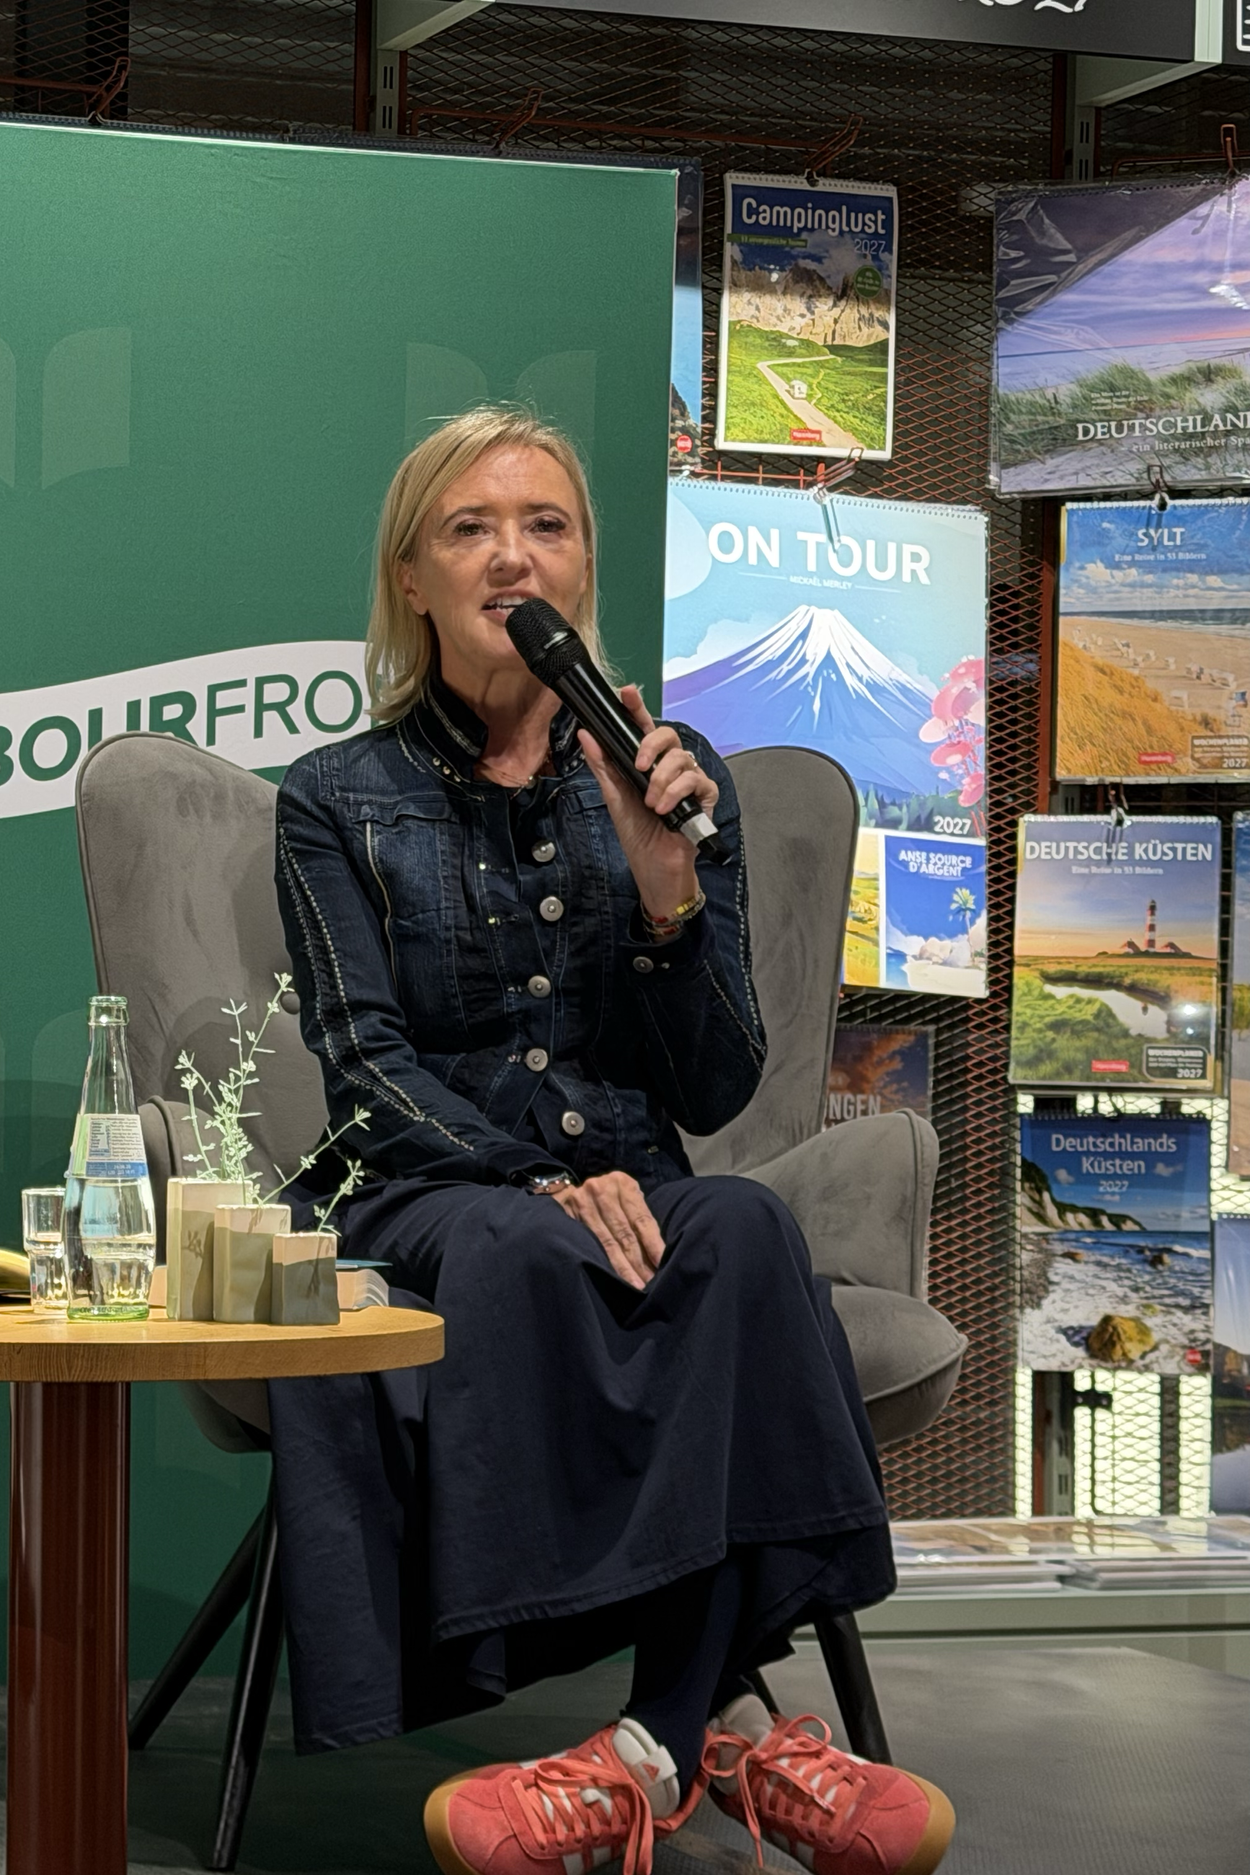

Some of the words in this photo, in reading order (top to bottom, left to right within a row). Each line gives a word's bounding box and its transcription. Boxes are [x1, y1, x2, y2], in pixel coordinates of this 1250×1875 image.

[742, 197, 886, 237] Campinglust
[854, 238, 886, 255] 2027
[1132, 443, 1150, 452] ein
[1155, 436, 1227, 451] literarischer
[1137, 527, 1185, 547] SYLT
[708, 522, 780, 568] ON
[796, 531, 931, 585] TOUR
[1156, 553, 1165, 561] in
[1222, 758, 1248, 768] 2027
[933, 815, 972, 835] 2027
[899, 849, 927, 863] ANSE
[929, 852, 972, 868] SOURCE
[1025, 841, 1129, 860] DEUTSCHE
[1134, 839, 1213, 861] KÜSTEN
[909, 861, 962, 877] D'ARGENT
[1176, 1068, 1203, 1078] 2027
[1051, 1133, 1177, 1152] Deutschlands
[1082, 1156, 1145, 1175] Küsten
[1099, 1180, 1129, 1192] 2027
